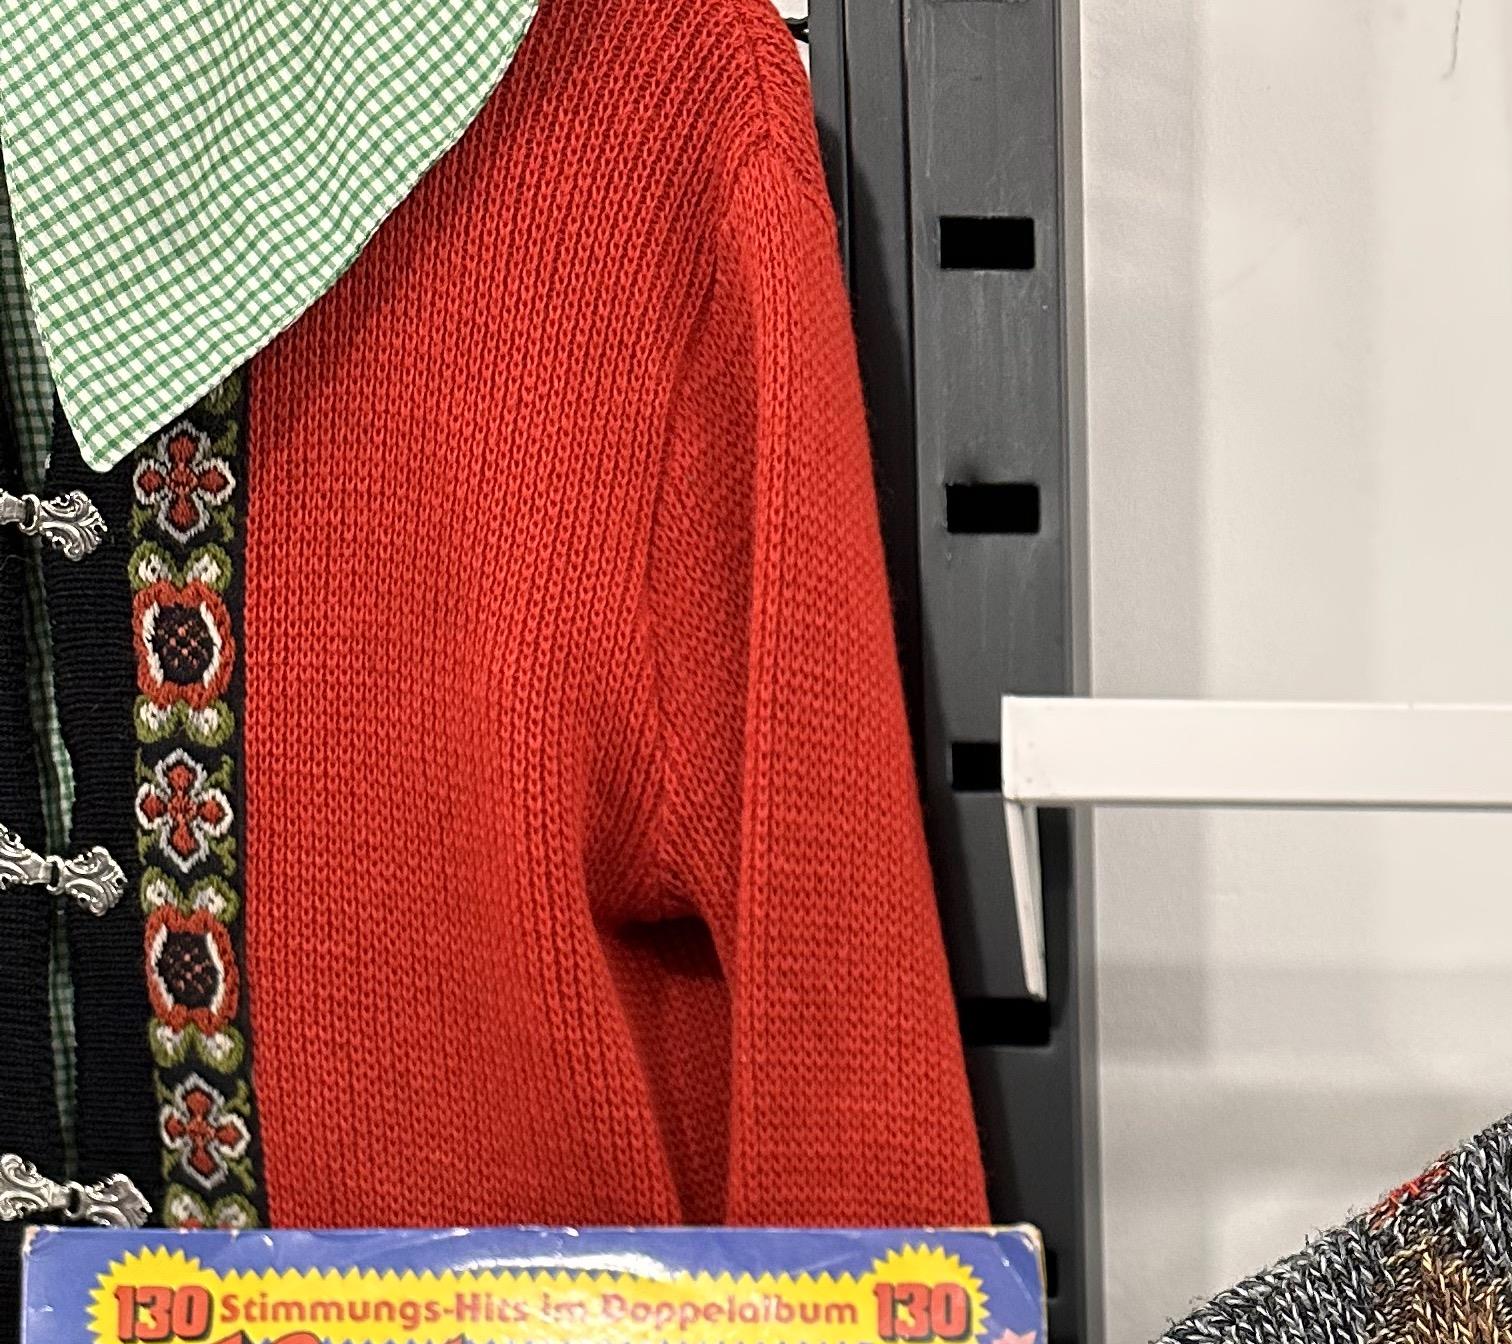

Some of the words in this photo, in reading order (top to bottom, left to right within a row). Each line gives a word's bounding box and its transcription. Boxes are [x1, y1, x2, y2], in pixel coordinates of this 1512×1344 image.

[114, 1285, 212, 1341] 130
[220, 1293, 529, 1330] Stimmungs-Hits
[542, 1291, 587, 1322] im
[601, 1293, 858, 1331] Doppelalbum
[873, 1282, 970, 1342] 130
